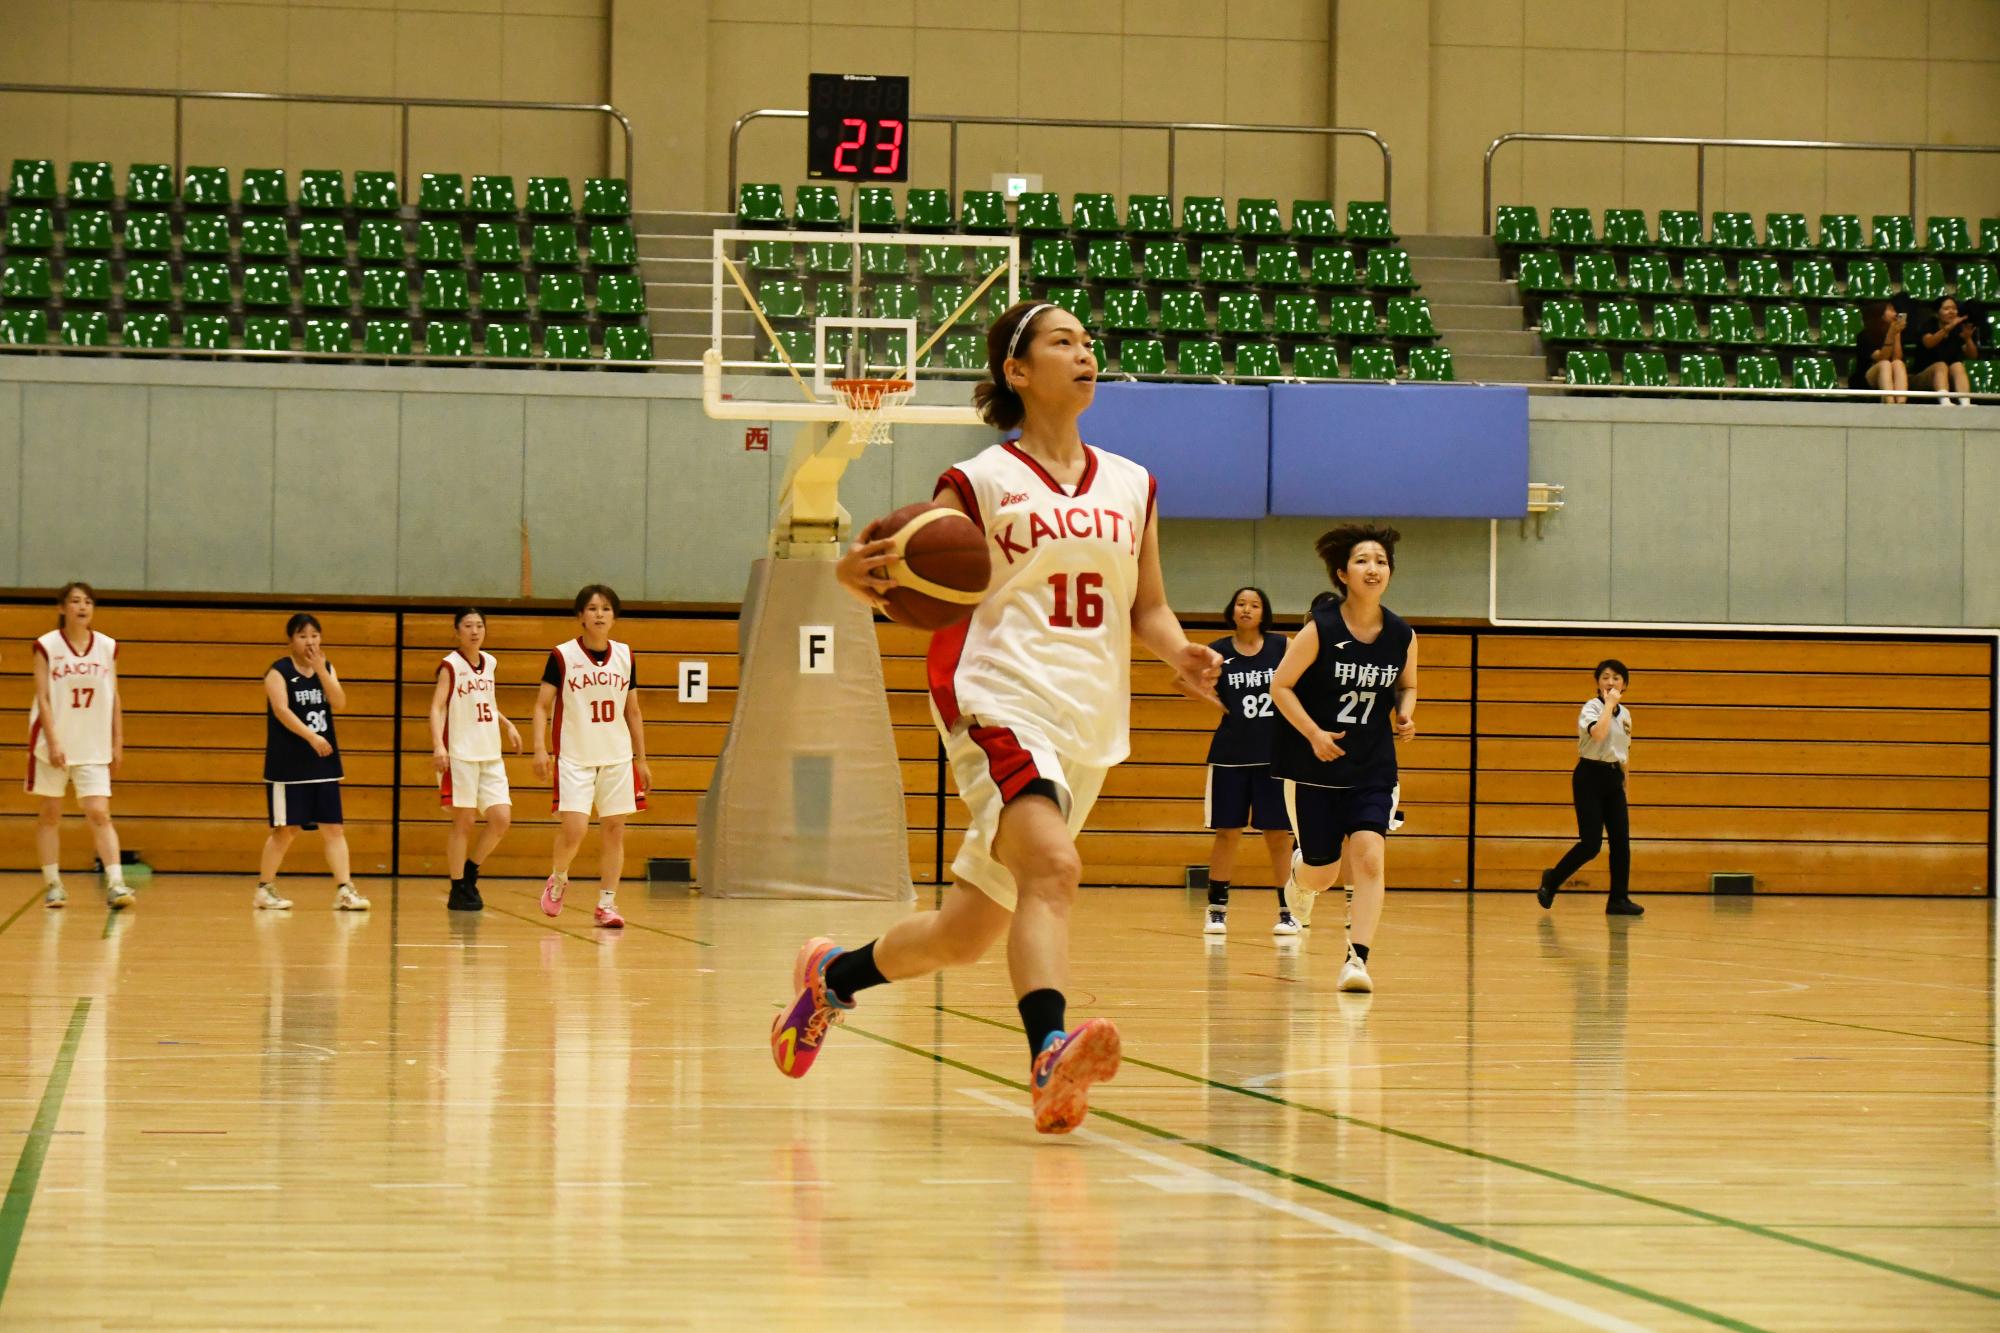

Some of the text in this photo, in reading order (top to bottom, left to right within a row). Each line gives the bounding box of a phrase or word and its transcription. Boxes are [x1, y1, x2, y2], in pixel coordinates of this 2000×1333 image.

[833, 118, 903, 174] 23
[745, 427, 769, 451] 西
[1048, 572, 1104, 628] 16
[810, 635, 826, 668] F
[568, 671, 629, 692] KAICITY
[687, 670, 701, 698] F
[1334, 661, 1399, 688] 甲府市
[71, 688, 95, 708] 17
[295, 688, 326, 706] 甲府
[1242, 692, 1274, 719] 82
[1336, 690, 1377, 725] 27
[476, 703, 493, 722] 15
[590, 700, 615, 723] 10
